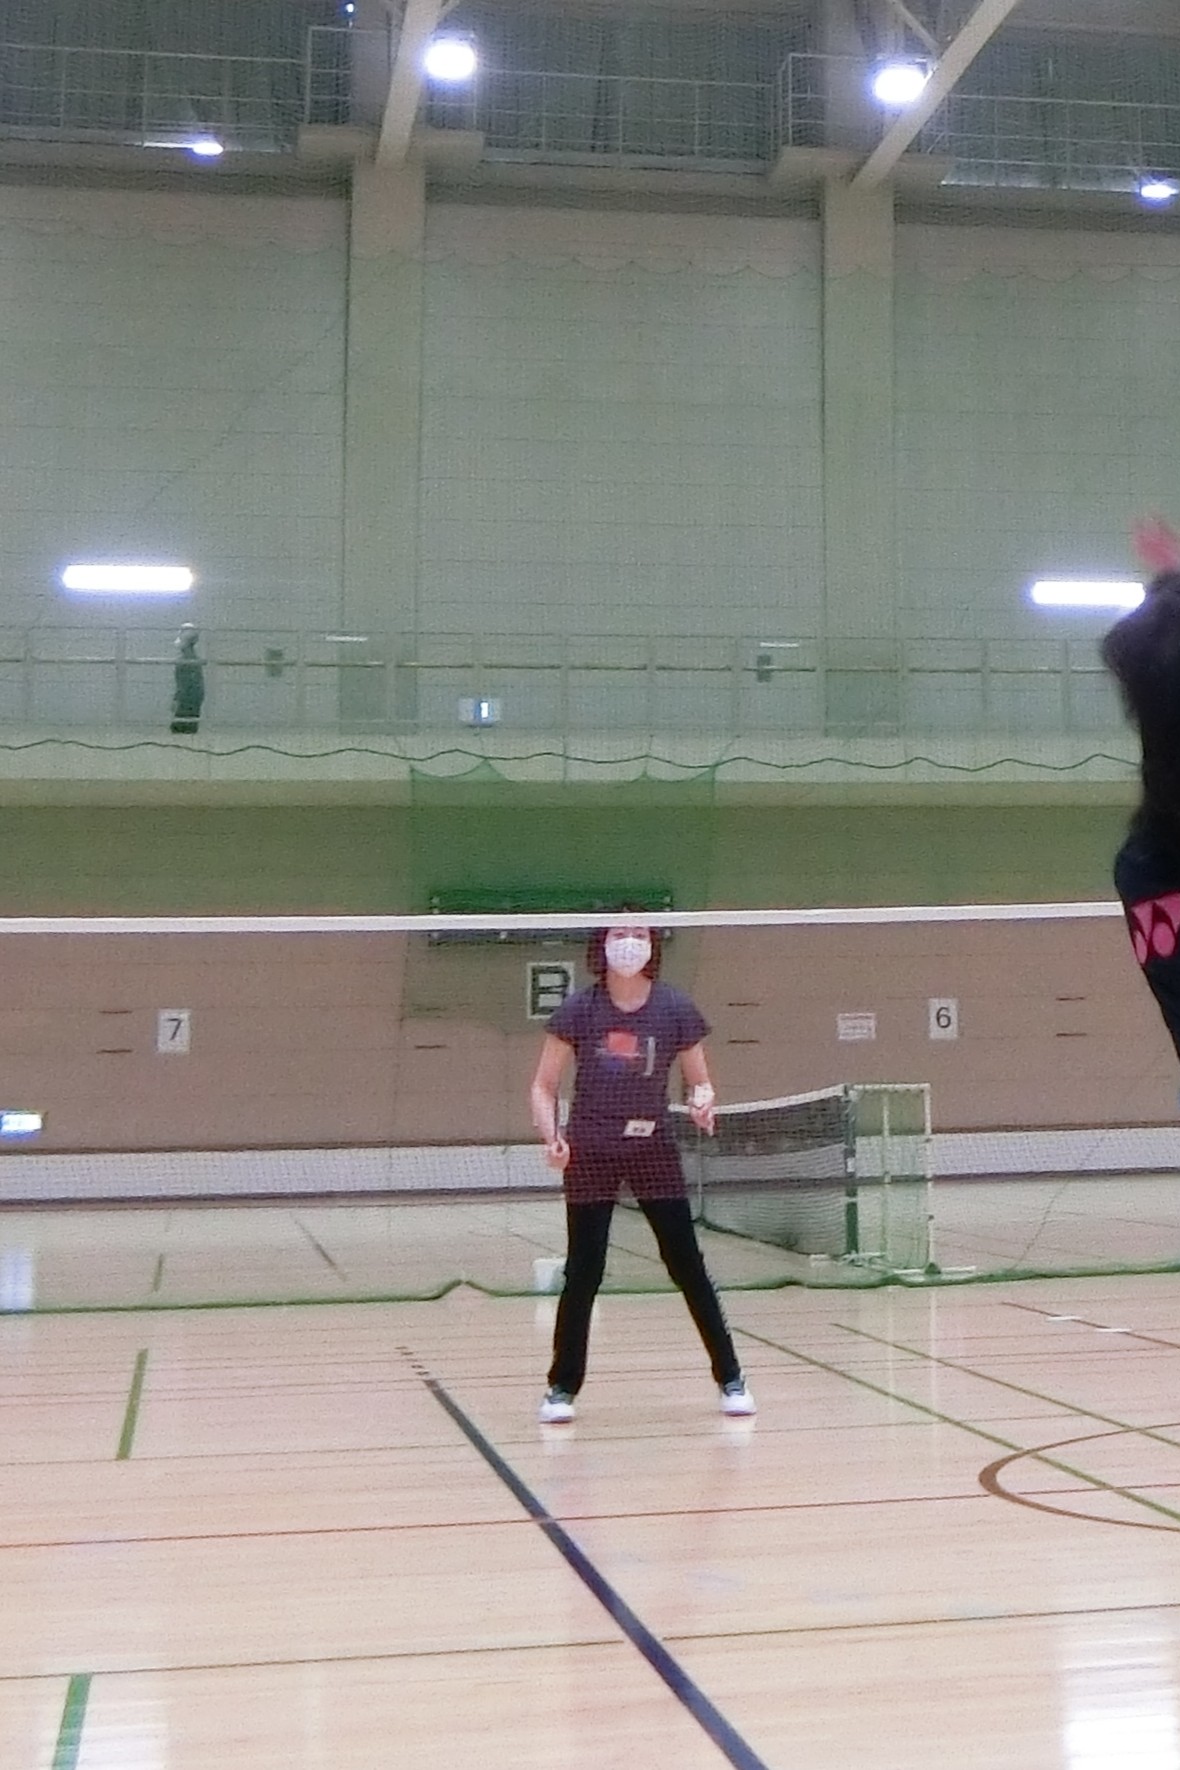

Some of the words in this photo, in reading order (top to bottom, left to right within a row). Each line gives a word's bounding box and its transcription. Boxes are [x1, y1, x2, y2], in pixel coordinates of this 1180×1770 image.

[531, 966, 571, 1015] B
[935, 1006, 952, 1029] 6
[167, 1018, 182, 1041] 7
